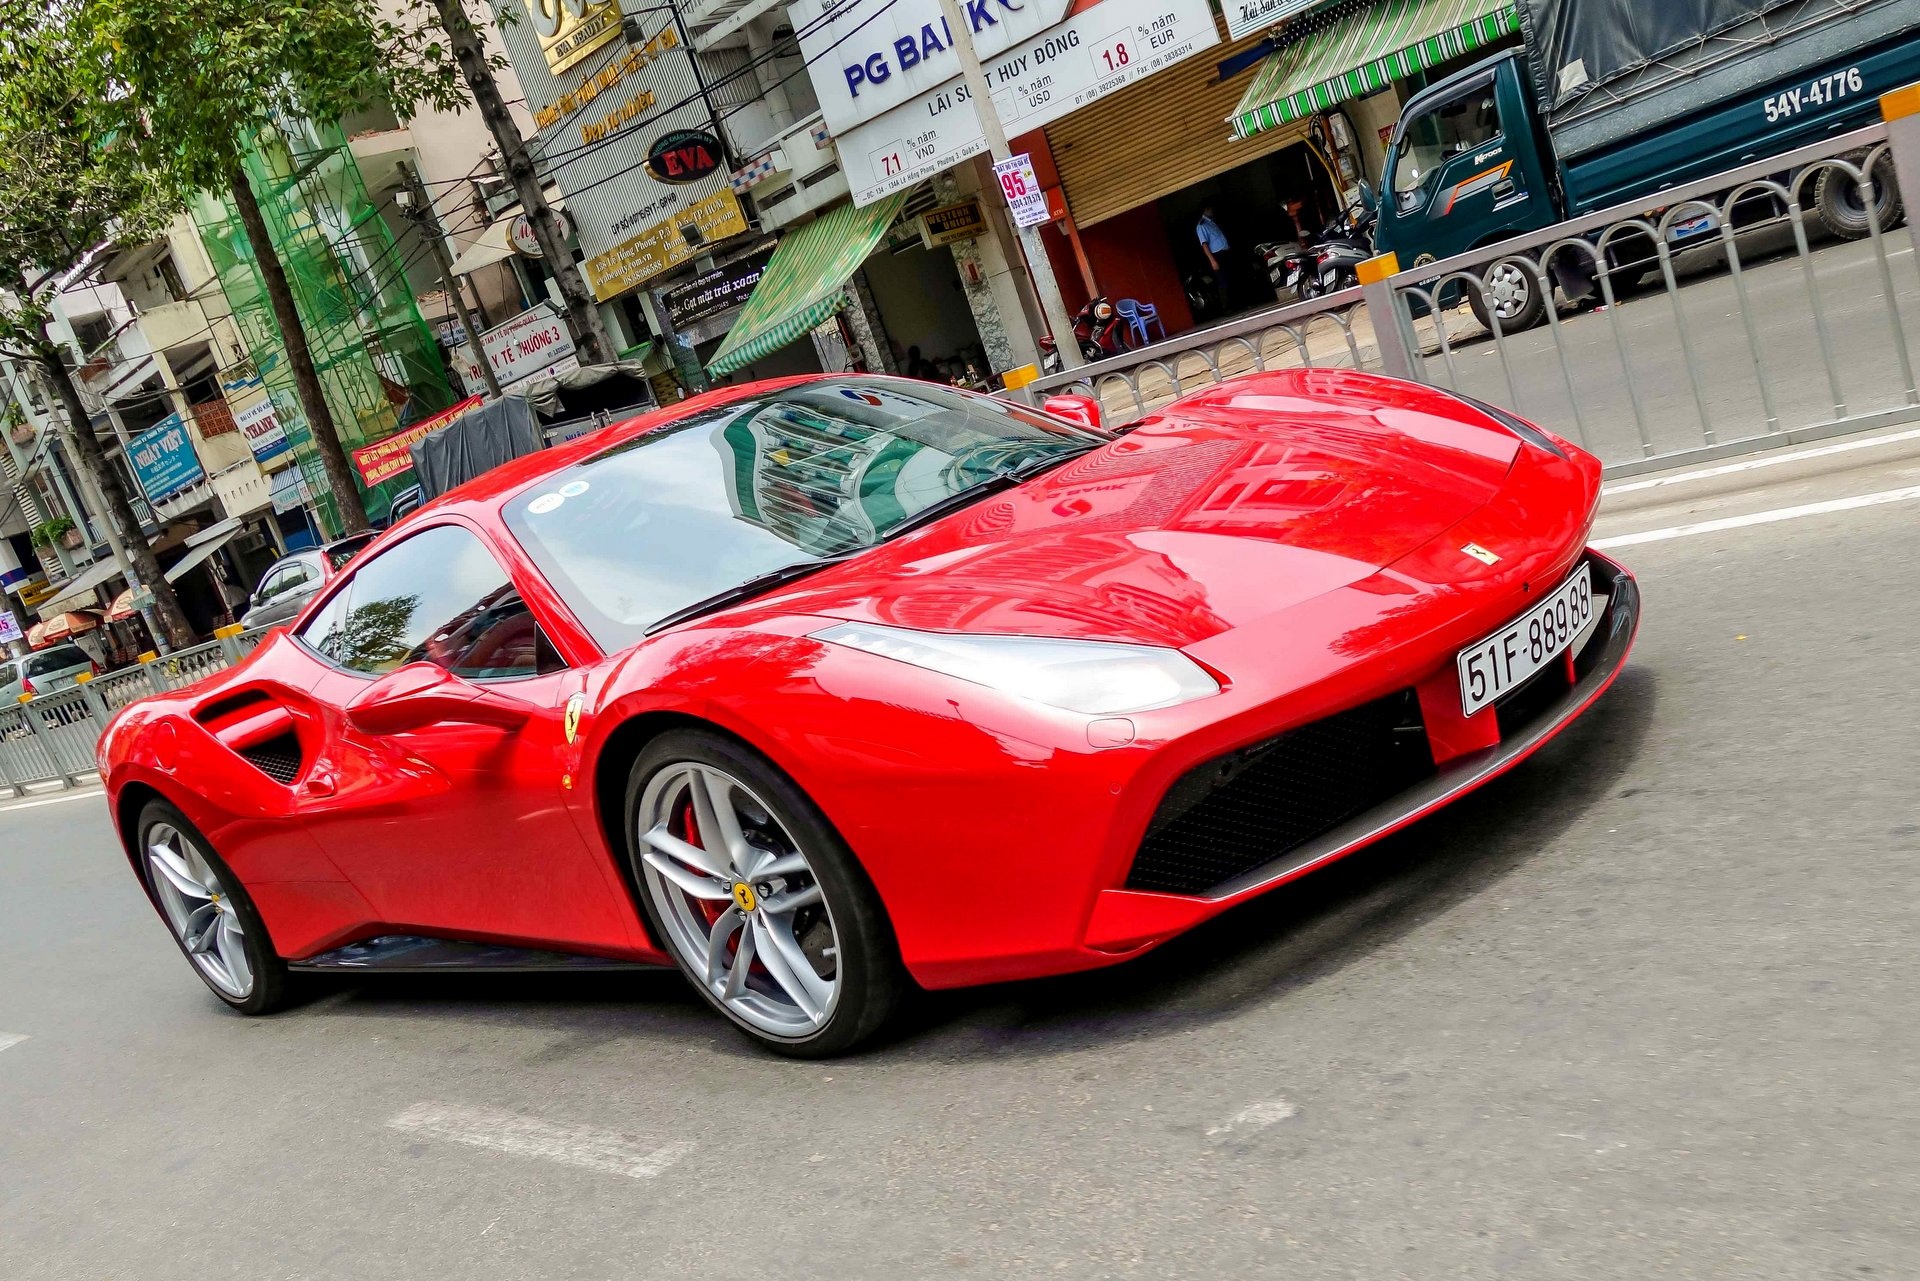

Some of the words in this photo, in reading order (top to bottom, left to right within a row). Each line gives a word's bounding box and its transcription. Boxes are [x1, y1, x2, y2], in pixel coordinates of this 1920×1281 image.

[572, 15, 605, 46] BEAUTY
[1138, 24, 1149, 36] %
[1152, 12, 1176, 31] năm
[1150, 29, 1175, 49] EUR
[1103, 43, 1129, 71] 1.8
[1136, 65, 1149, 75] Fax:
[1151, 58, 1163, 70] (08)
[844, 52, 891, 97] PG
[928, 92, 951, 117] LÃI
[998, 55, 1028, 83] HUY
[1035, 29, 1080, 65] ĐỘNG
[1018, 85, 1029, 96] %
[1030, 74, 1052, 91] năm
[1029, 90, 1051, 108] USD
[1764, 67, 1863, 122] 54Y-4776
[907, 139, 916, 149] %
[917, 130, 937, 143] năm
[662, 145, 715, 176] EVA
[882, 152, 902, 176] 7.1
[915, 144, 936, 160] VND
[1001, 171, 1027, 199] 95
[927, 207, 969, 225] WESTERN
[943, 215, 972, 230] UNION
[714, 281, 731, 297] trái
[733, 272, 760, 291] xoan
[492, 354, 500, 369] Y
[501, 341, 515, 364] TẾ
[552, 326, 560, 341] 3
[245, 415, 277, 439] THANH
[135, 443, 162, 470] NHẬT
[159, 428, 184, 453] VIỆT
[1467, 575, 1589, 702] 51F-889.88
